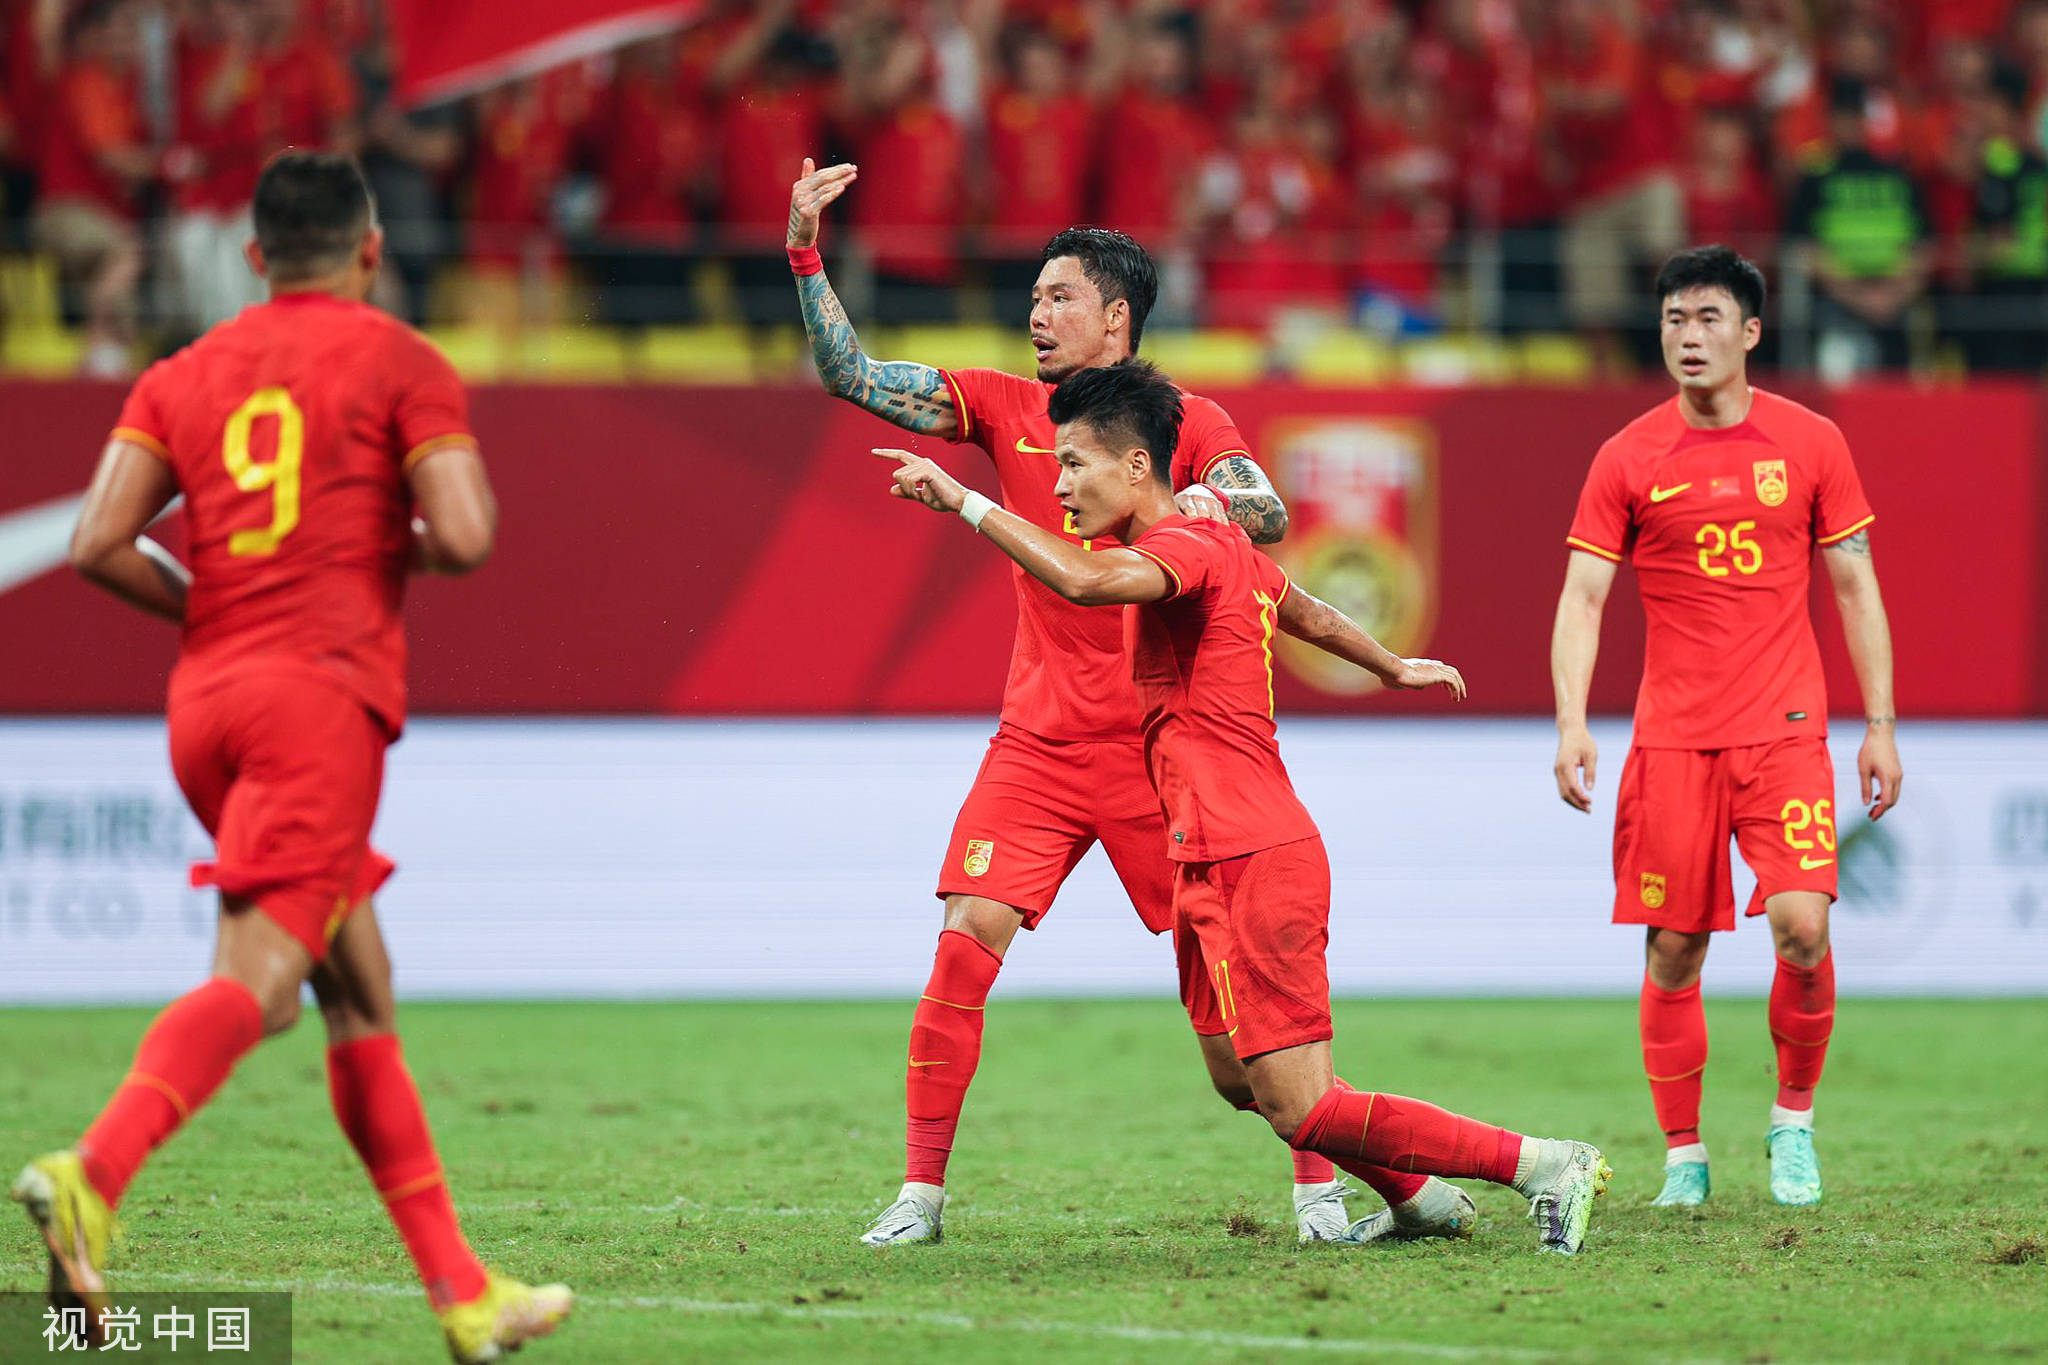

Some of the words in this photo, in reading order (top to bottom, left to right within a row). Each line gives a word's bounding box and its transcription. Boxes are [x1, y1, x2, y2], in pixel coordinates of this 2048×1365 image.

[222, 387, 304, 557] 9
[1696, 520, 1762, 576] 25
[1781, 798, 1836, 851] 25
